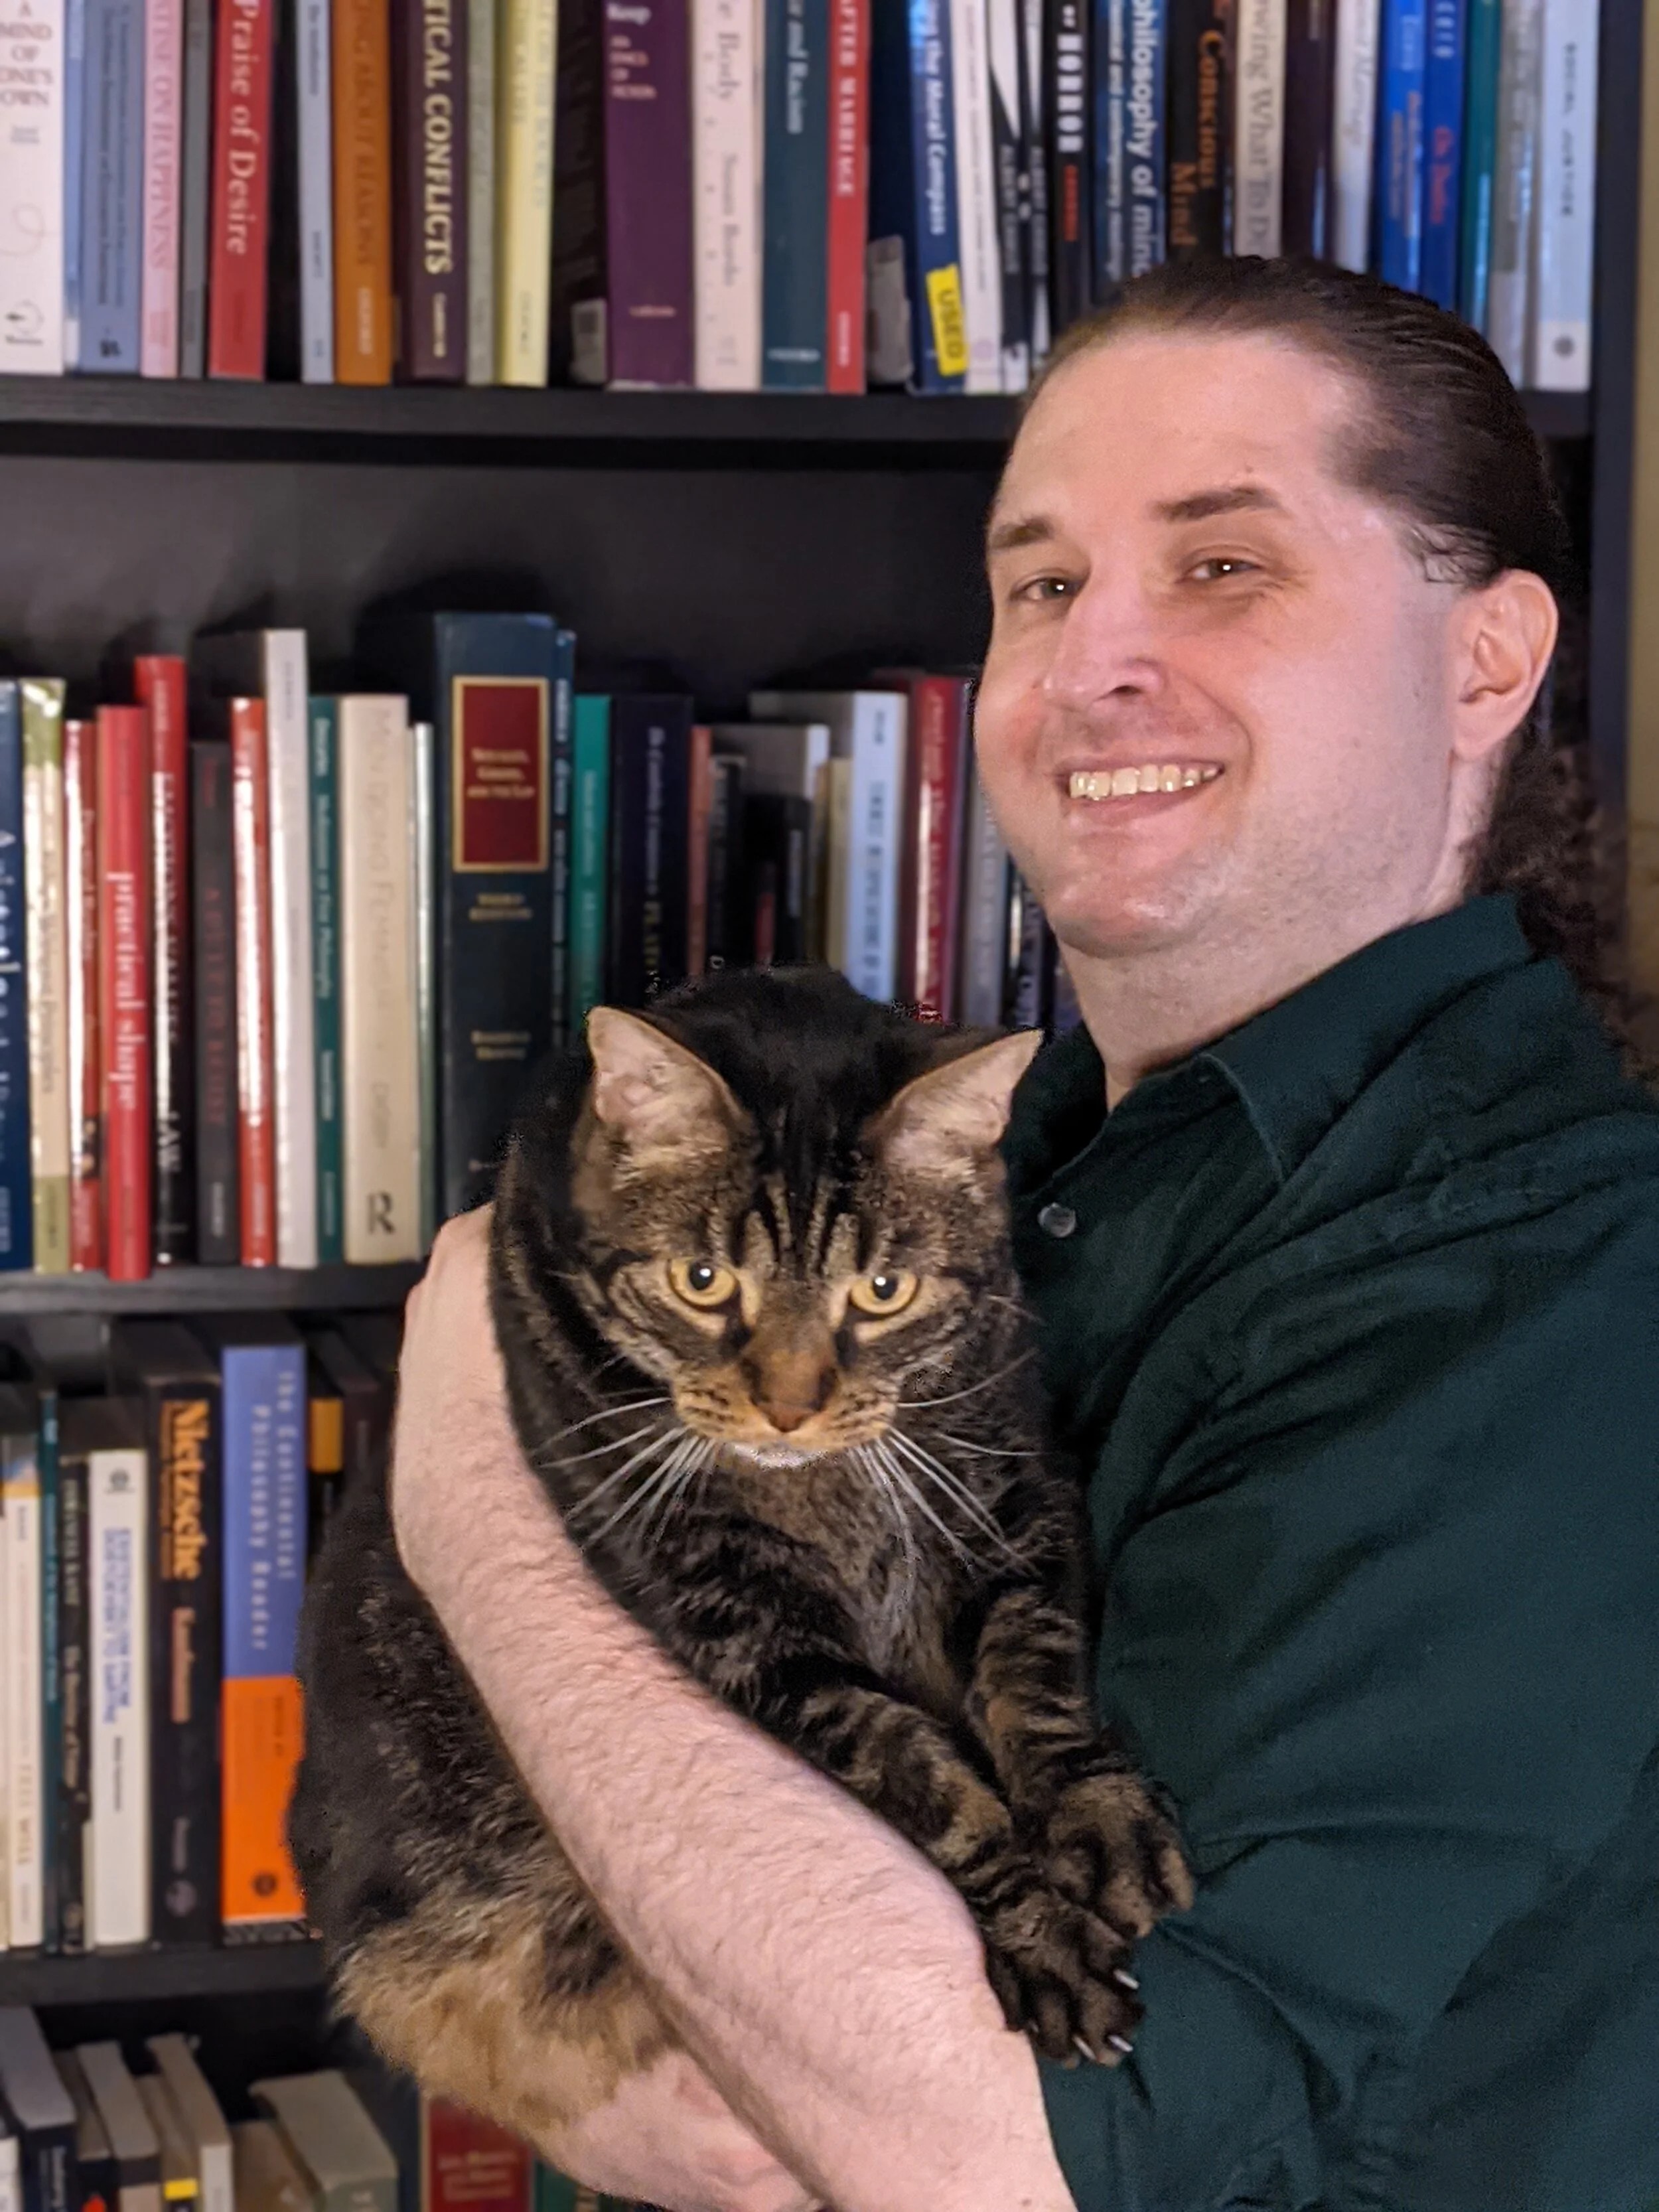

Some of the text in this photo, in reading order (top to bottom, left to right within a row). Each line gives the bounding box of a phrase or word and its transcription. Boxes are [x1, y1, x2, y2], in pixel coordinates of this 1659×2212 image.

[0, 22, 52, 40] MIND
[18, 0, 33, 17] A
[11, 44, 40, 62] OF
[717, 33, 742, 102] Body
[924, 41, 944, 75] the
[0, 88, 50, 107] OWN
[152, 76, 173, 115] ON
[226, 0, 260, 256] Praise of Desire
[924, 80, 945, 139] Moral
[1199, 30, 1224, 189] Conscious
[1249, 88, 1276, 167] What
[837, 77, 857, 197] MARRIAGE
[150, 123, 174, 270] HAPPINESS
[424, 94, 453, 274] CONFLICTS
[926, 143, 948, 236] Compass
[1001, 145, 1019, 208] ALBERT
[1031, 146, 1048, 209] ALBERT
[1131, 166, 1157, 197] of
[1171, 162, 1198, 246] Mind
[1249, 178, 1273, 209] To
[938, 289, 966, 359] USED
[105, 872, 147, 1111] practical shape
[171, 1399, 210, 1580] Nietzsche
[248, 1404, 273, 1651] Philosophy Reader
